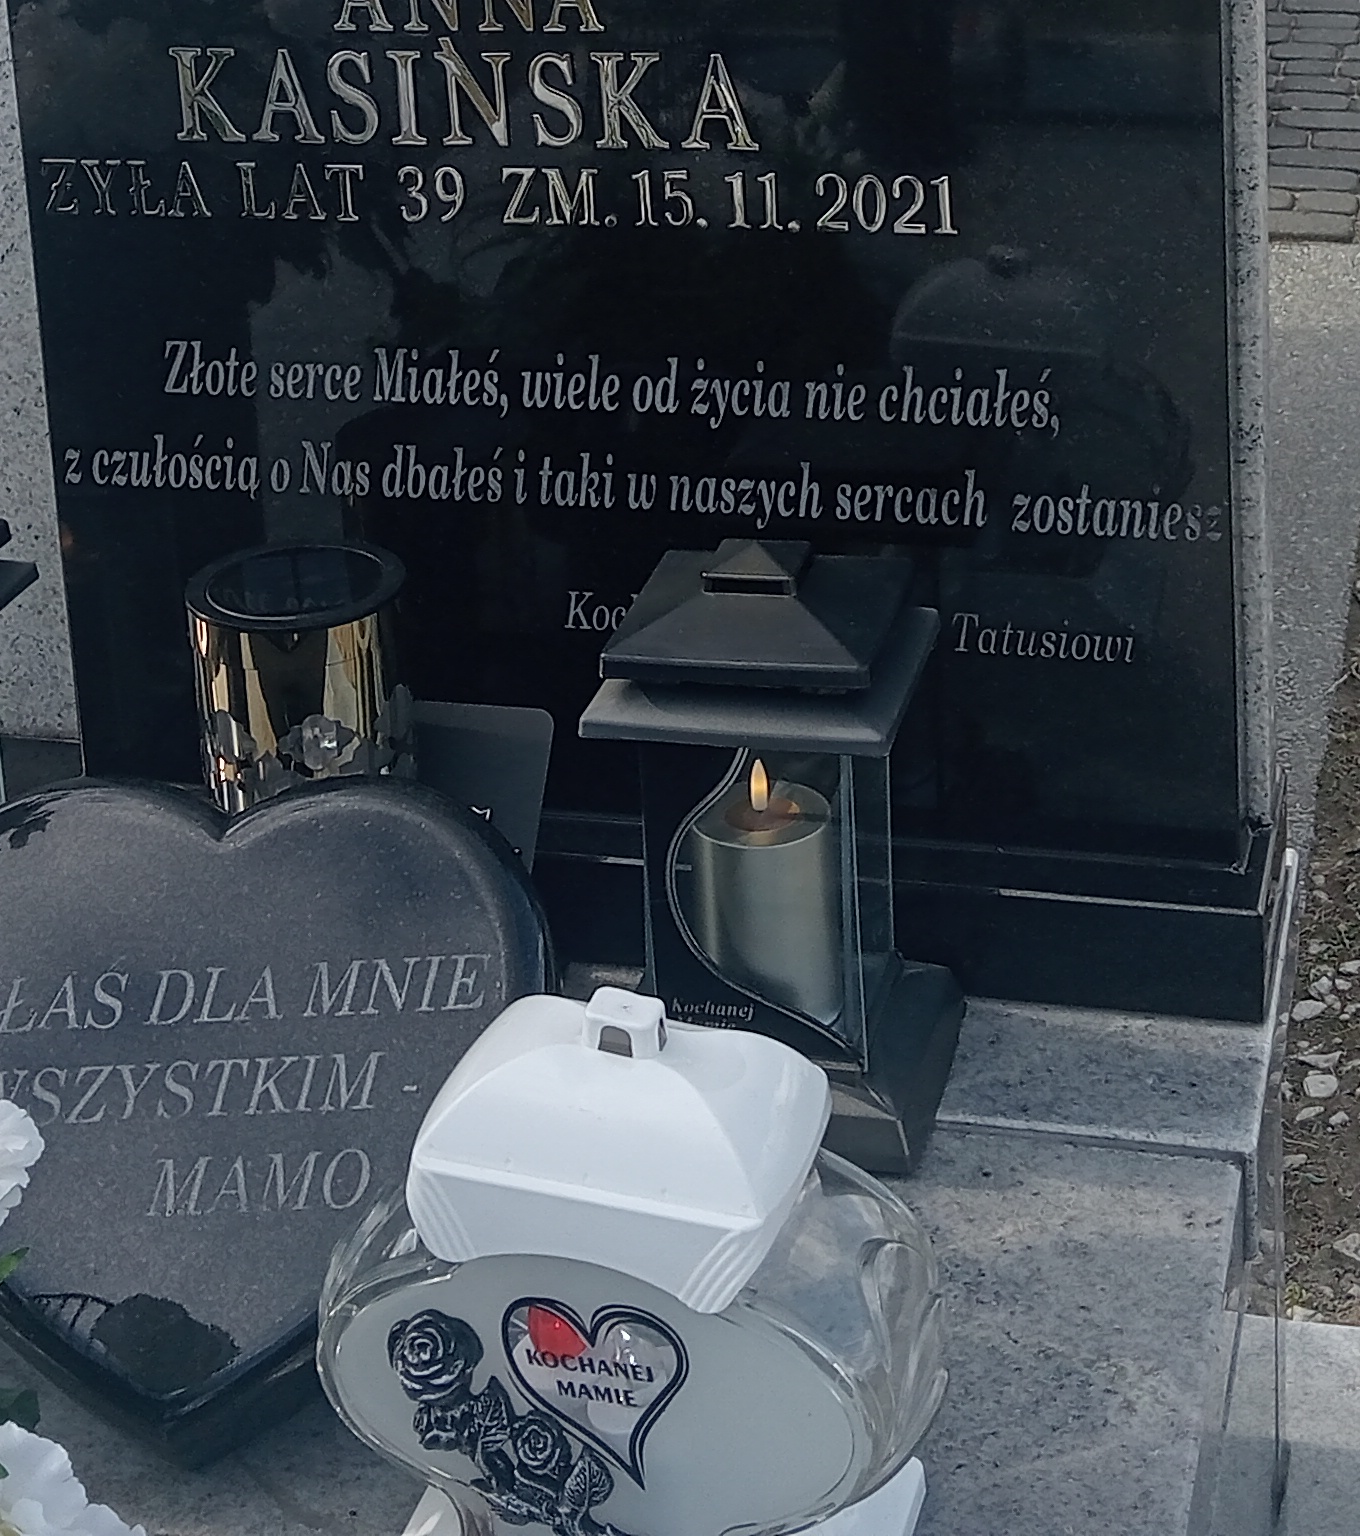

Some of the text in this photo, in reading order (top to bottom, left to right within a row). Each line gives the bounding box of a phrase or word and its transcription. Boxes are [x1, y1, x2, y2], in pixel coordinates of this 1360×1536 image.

[236, 161, 366, 222] LAT
[397, 164, 465, 223] 39
[501, 167, 618, 228] ZM.
[164, 340, 1061, 437] Złote serce Miałeś, wiele od życia nie chciałeś,
[63, 434, 1223, 543] z czułością o Nas dbałeś i taki w naszych sercach zostaniesz
[564, 590, 1136, 663] Koc Tatusiowi
[143, 966, 282, 1026] DLA
[303, 953, 490, 1017] MNIE
[672, 997, 755, 1022] Kochanej
[147, 1148, 372, 1217] MAMO
[525, 1348, 654, 1383] KOCHANEJ
[556, 1378, 638, 1408] MAMIE
